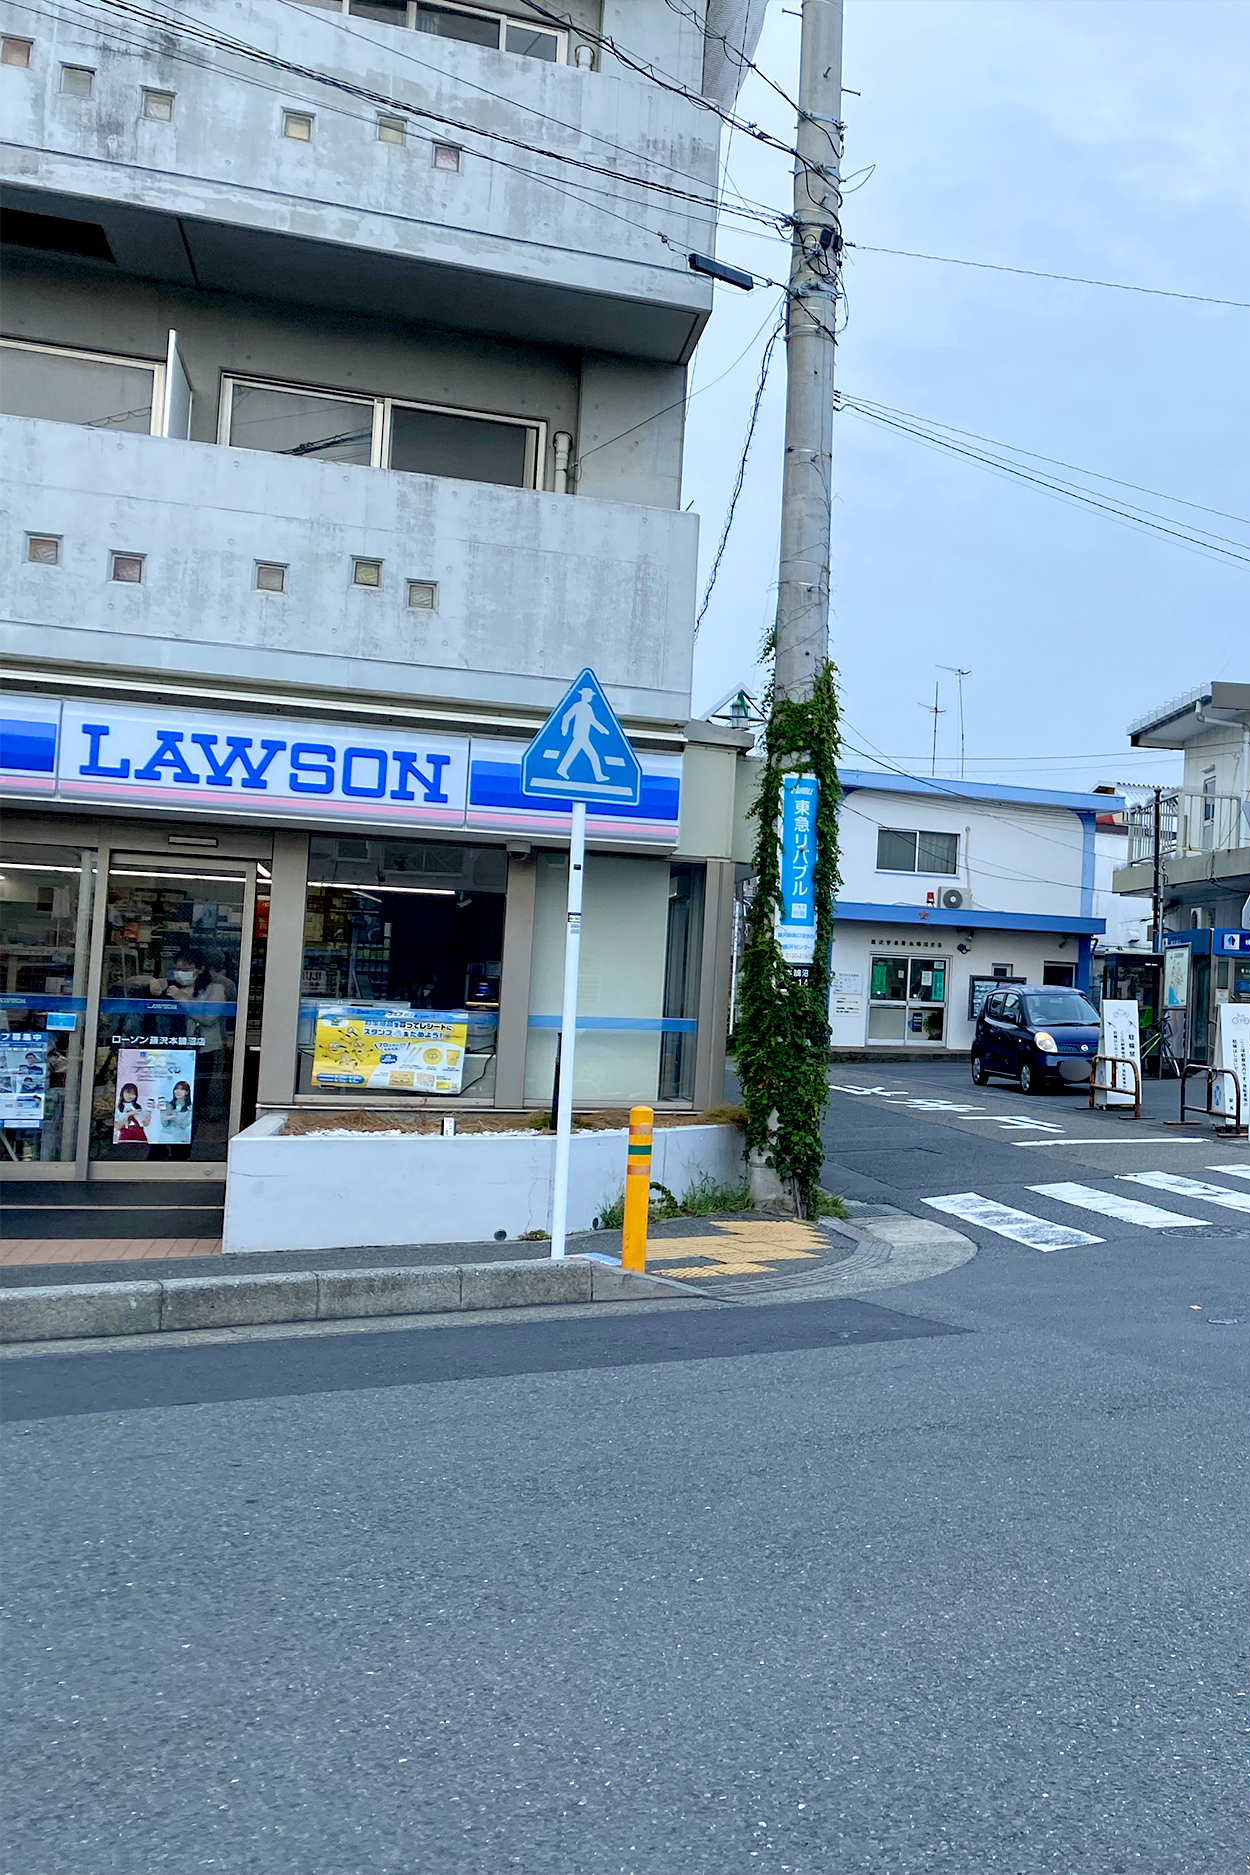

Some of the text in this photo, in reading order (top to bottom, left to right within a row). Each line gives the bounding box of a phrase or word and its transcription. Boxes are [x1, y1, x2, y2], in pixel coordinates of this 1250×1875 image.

[79, 724, 451, 803] LAWSON
[792, 799, 811, 897] 東急リバブル
[1128, 1033, 1136, 1058] 駐輪禁
